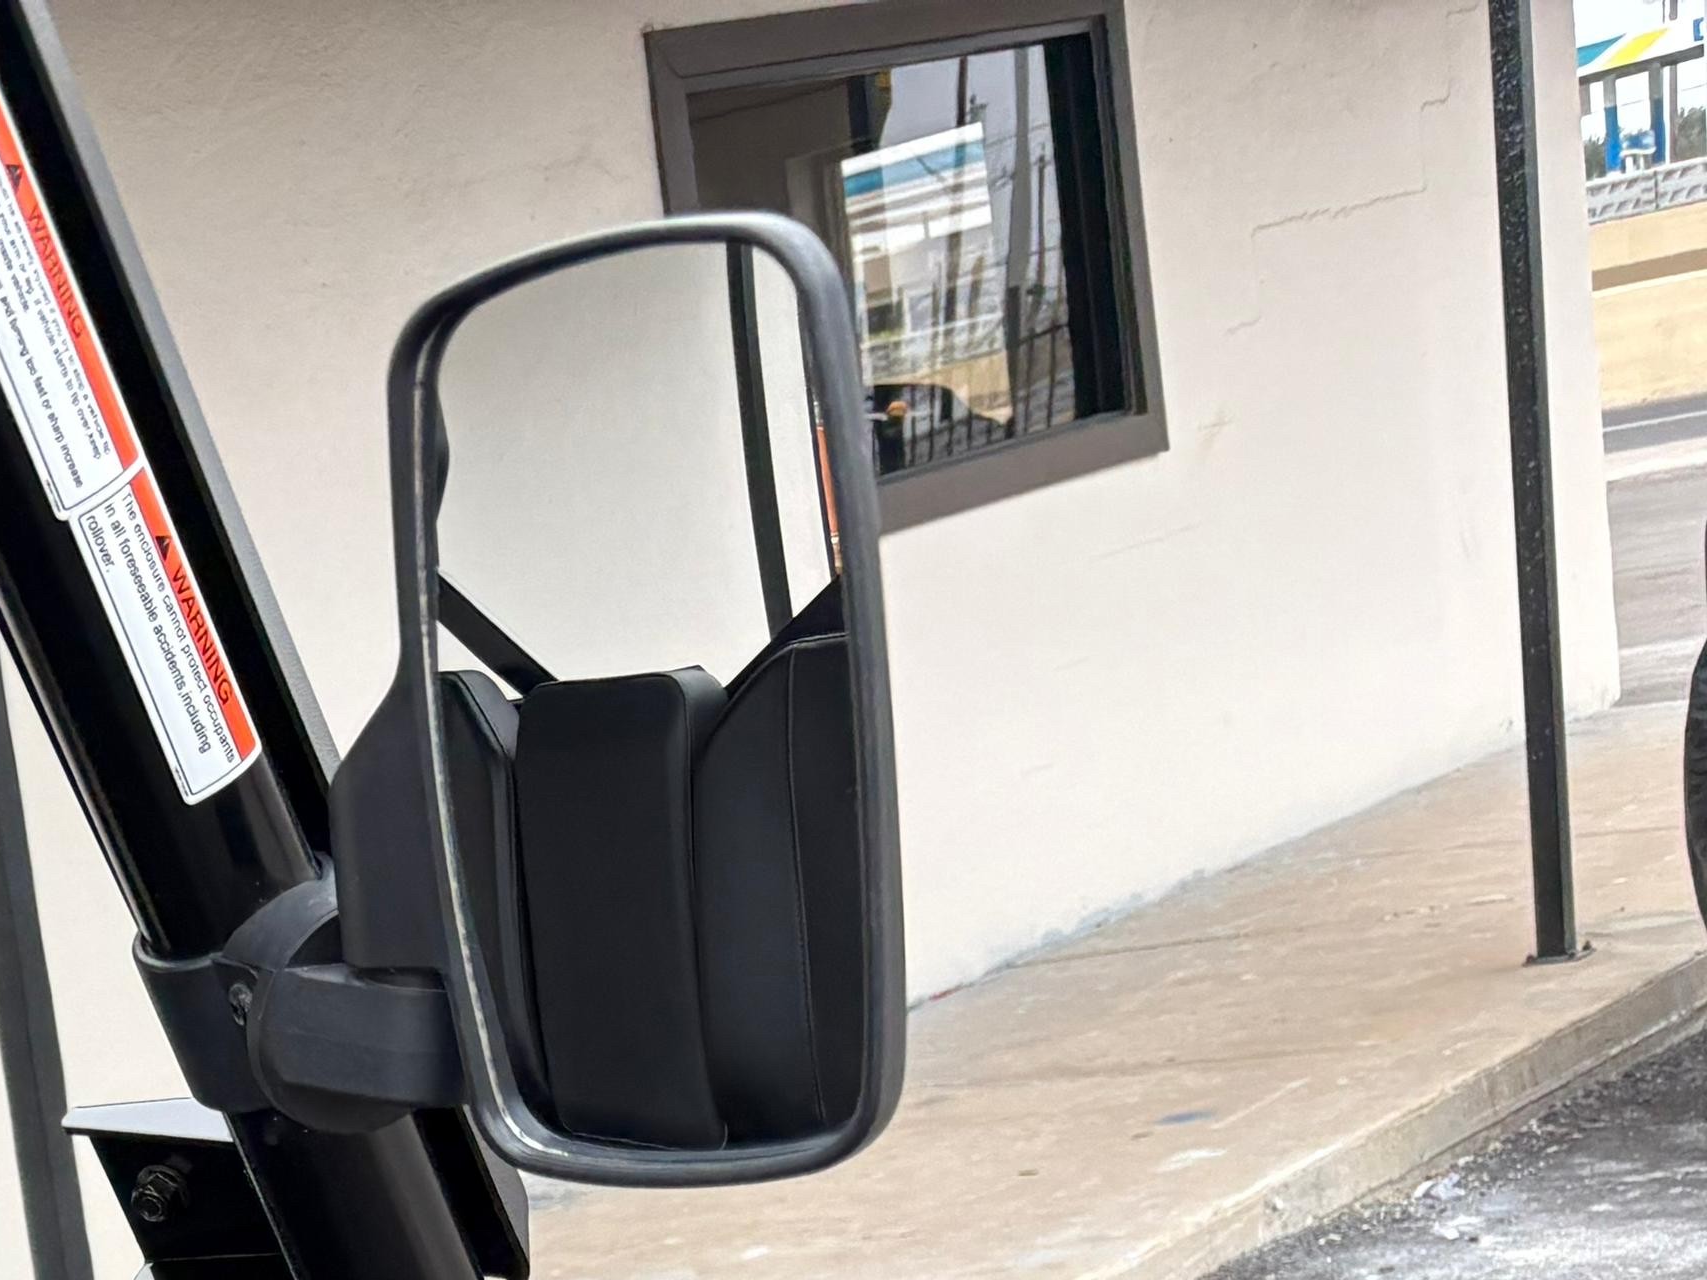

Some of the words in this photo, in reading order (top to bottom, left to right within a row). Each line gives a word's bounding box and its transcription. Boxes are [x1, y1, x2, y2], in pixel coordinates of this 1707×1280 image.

[29, 206, 83, 339] WARNING
[103, 501, 117, 519] in
[110, 517, 126, 539] all
[117, 536, 160, 624] foreseeable
[120, 491, 139, 521] The
[132, 521, 168, 593] enclosure
[160, 592, 188, 643] cannot
[180, 641, 208, 694] protect
[200, 692, 237, 765] occupants
[172, 567, 230, 706] WARNING
